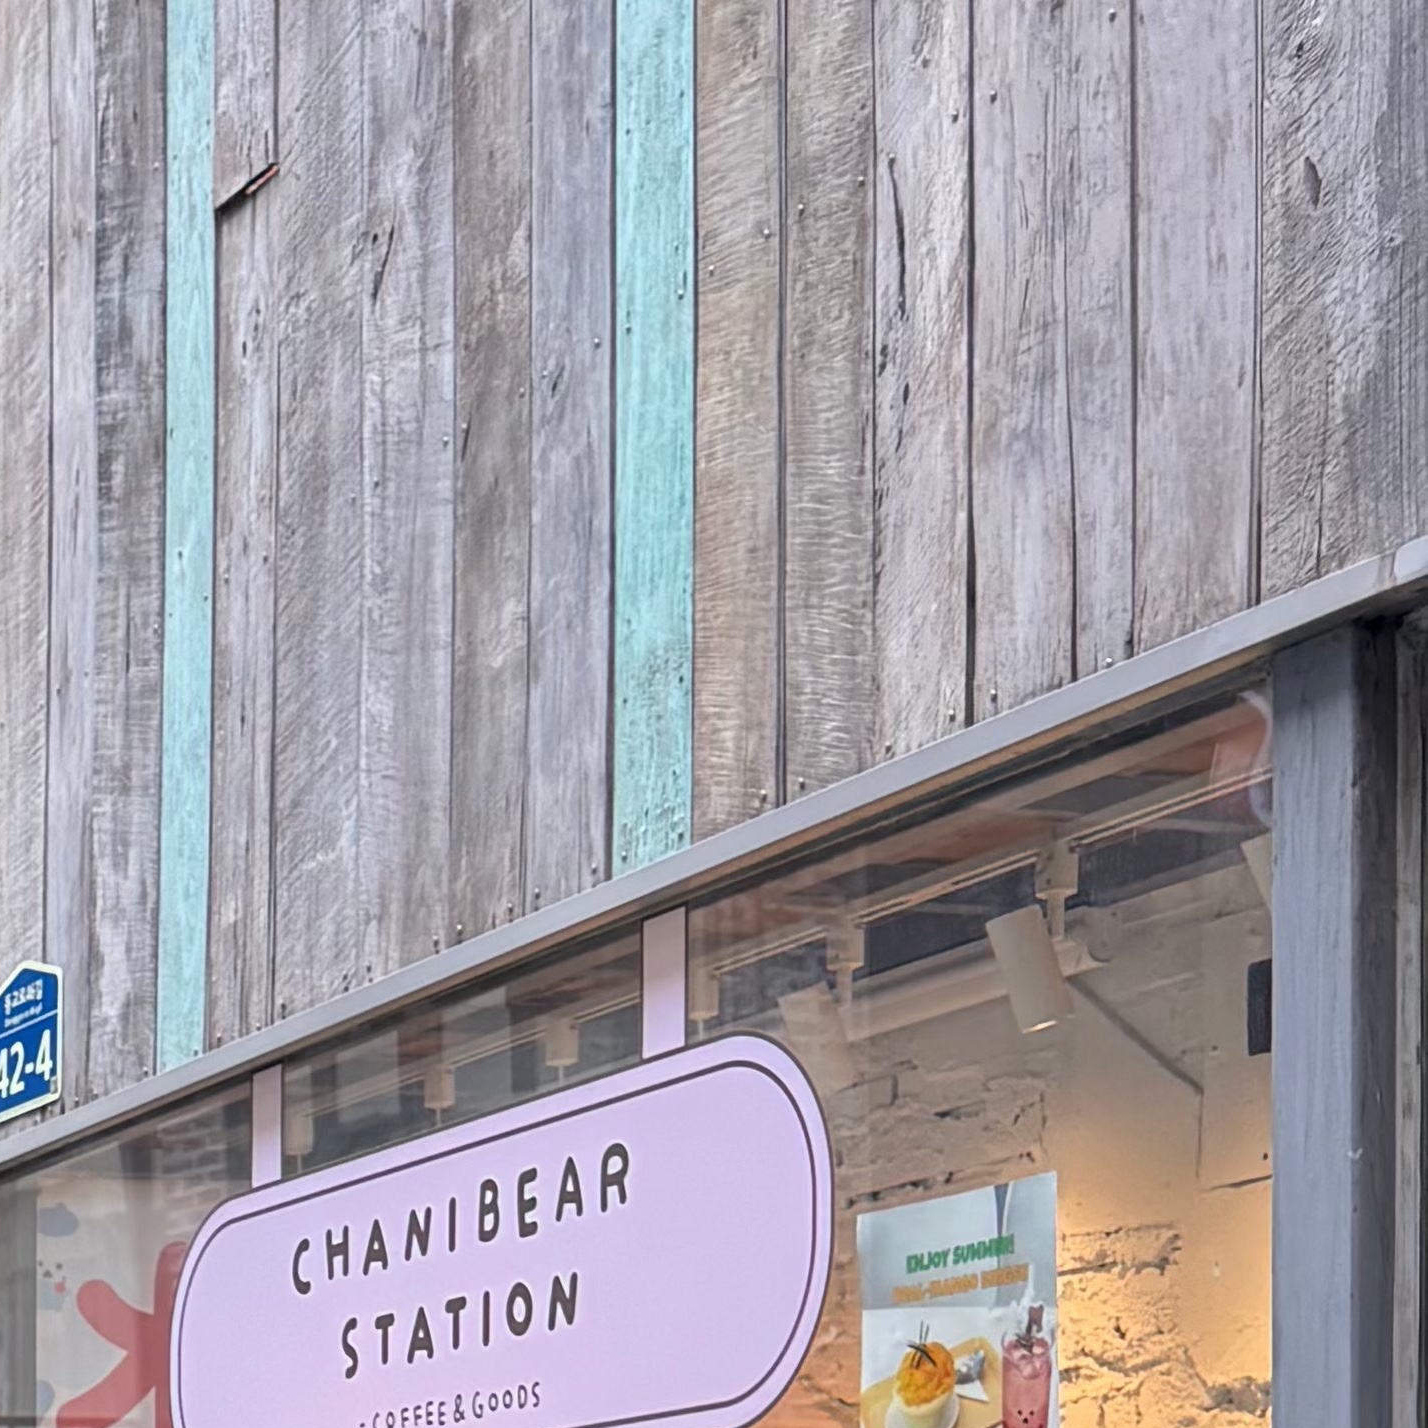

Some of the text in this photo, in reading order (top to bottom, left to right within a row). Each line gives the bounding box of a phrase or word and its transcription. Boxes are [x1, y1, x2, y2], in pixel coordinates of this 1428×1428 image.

[292, 1142, 630, 1295] CHANIBEAR
[906, 1248, 951, 1274] ENJOY
[341, 1272, 578, 1380] STATION
